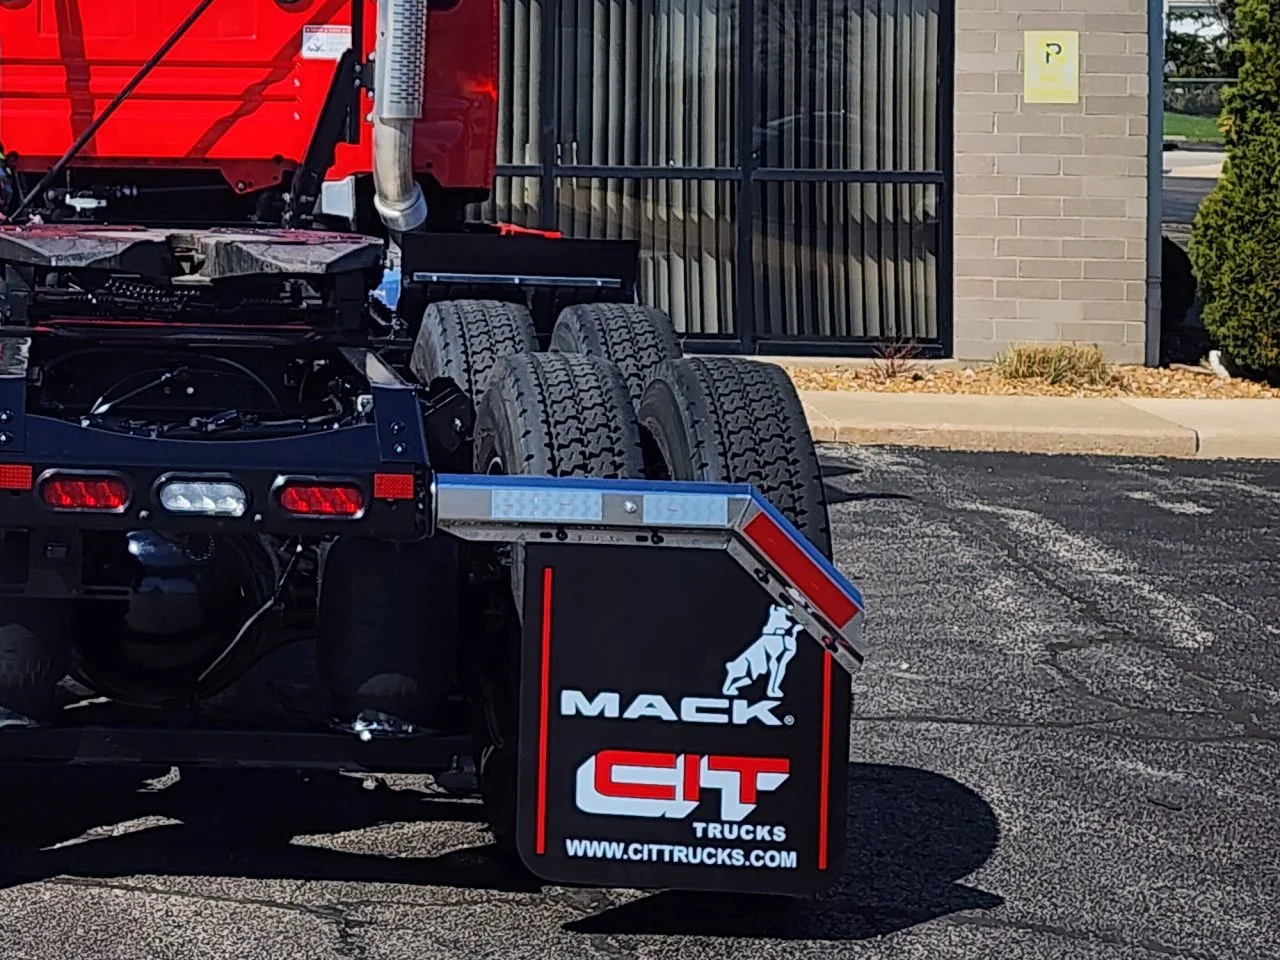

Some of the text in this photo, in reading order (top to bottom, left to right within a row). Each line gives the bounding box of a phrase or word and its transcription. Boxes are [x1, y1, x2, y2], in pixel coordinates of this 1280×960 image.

[594, 749, 790, 804] CIT
[692, 821, 787, 841] TRUCKS
[565, 839, 797, 869] WWW.CITTRUCKS.COM
